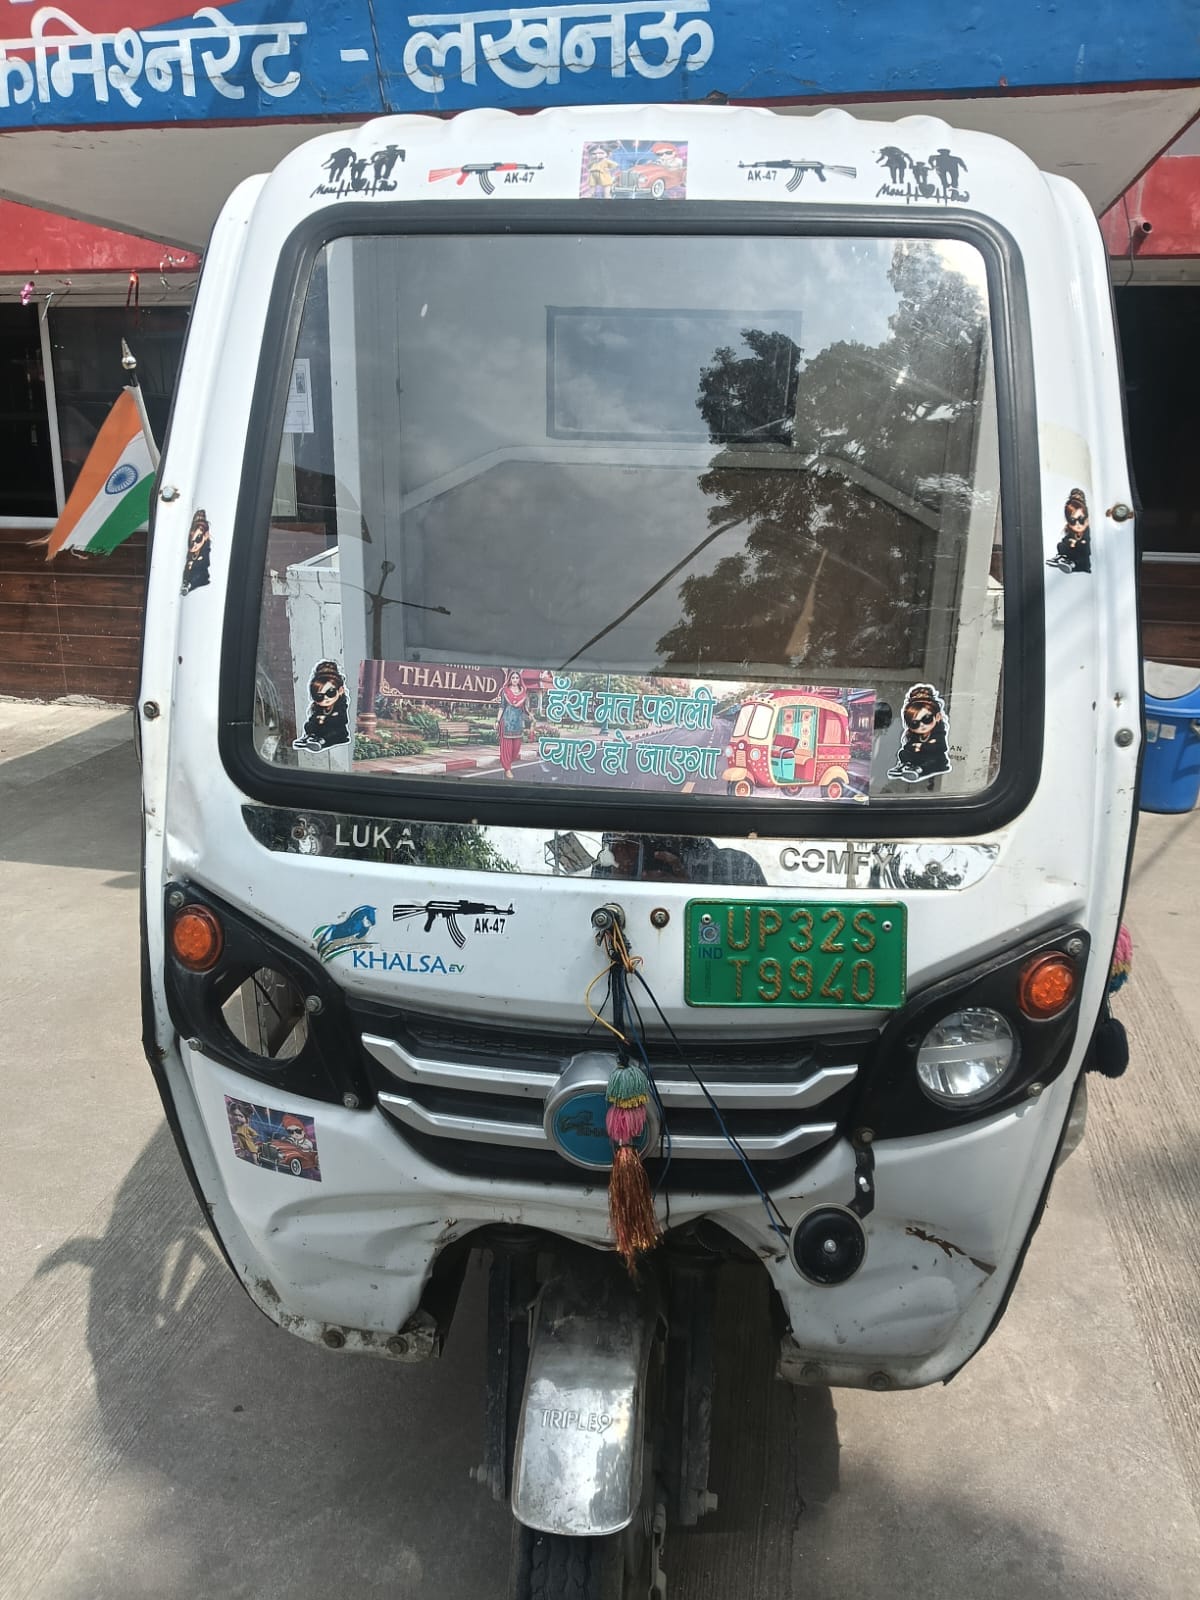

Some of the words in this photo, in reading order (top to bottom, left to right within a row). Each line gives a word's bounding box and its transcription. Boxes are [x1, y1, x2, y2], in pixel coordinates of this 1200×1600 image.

[403, 0, 715, 93] लखनऊ
[504, 171, 535, 185] AK-47
[747, 170, 777, 181] AK-47
[399, 664, 497, 693] THAILAND
[595, 690, 639, 726] मत
[643, 686, 717, 731] पगली
[538, 735, 597, 775] प्यार
[601, 729, 634, 777] हो
[636, 742, 722, 785] जाएगा
[473, 917, 507, 934] AK-47
[726, 906, 877, 953] UP32S
[353, 950, 447, 974] KHALSA
[698, 947, 724, 960] IND
[726, 957, 876, 1001] T9940
[540, 1409, 613, 1433] TRIPLE9
